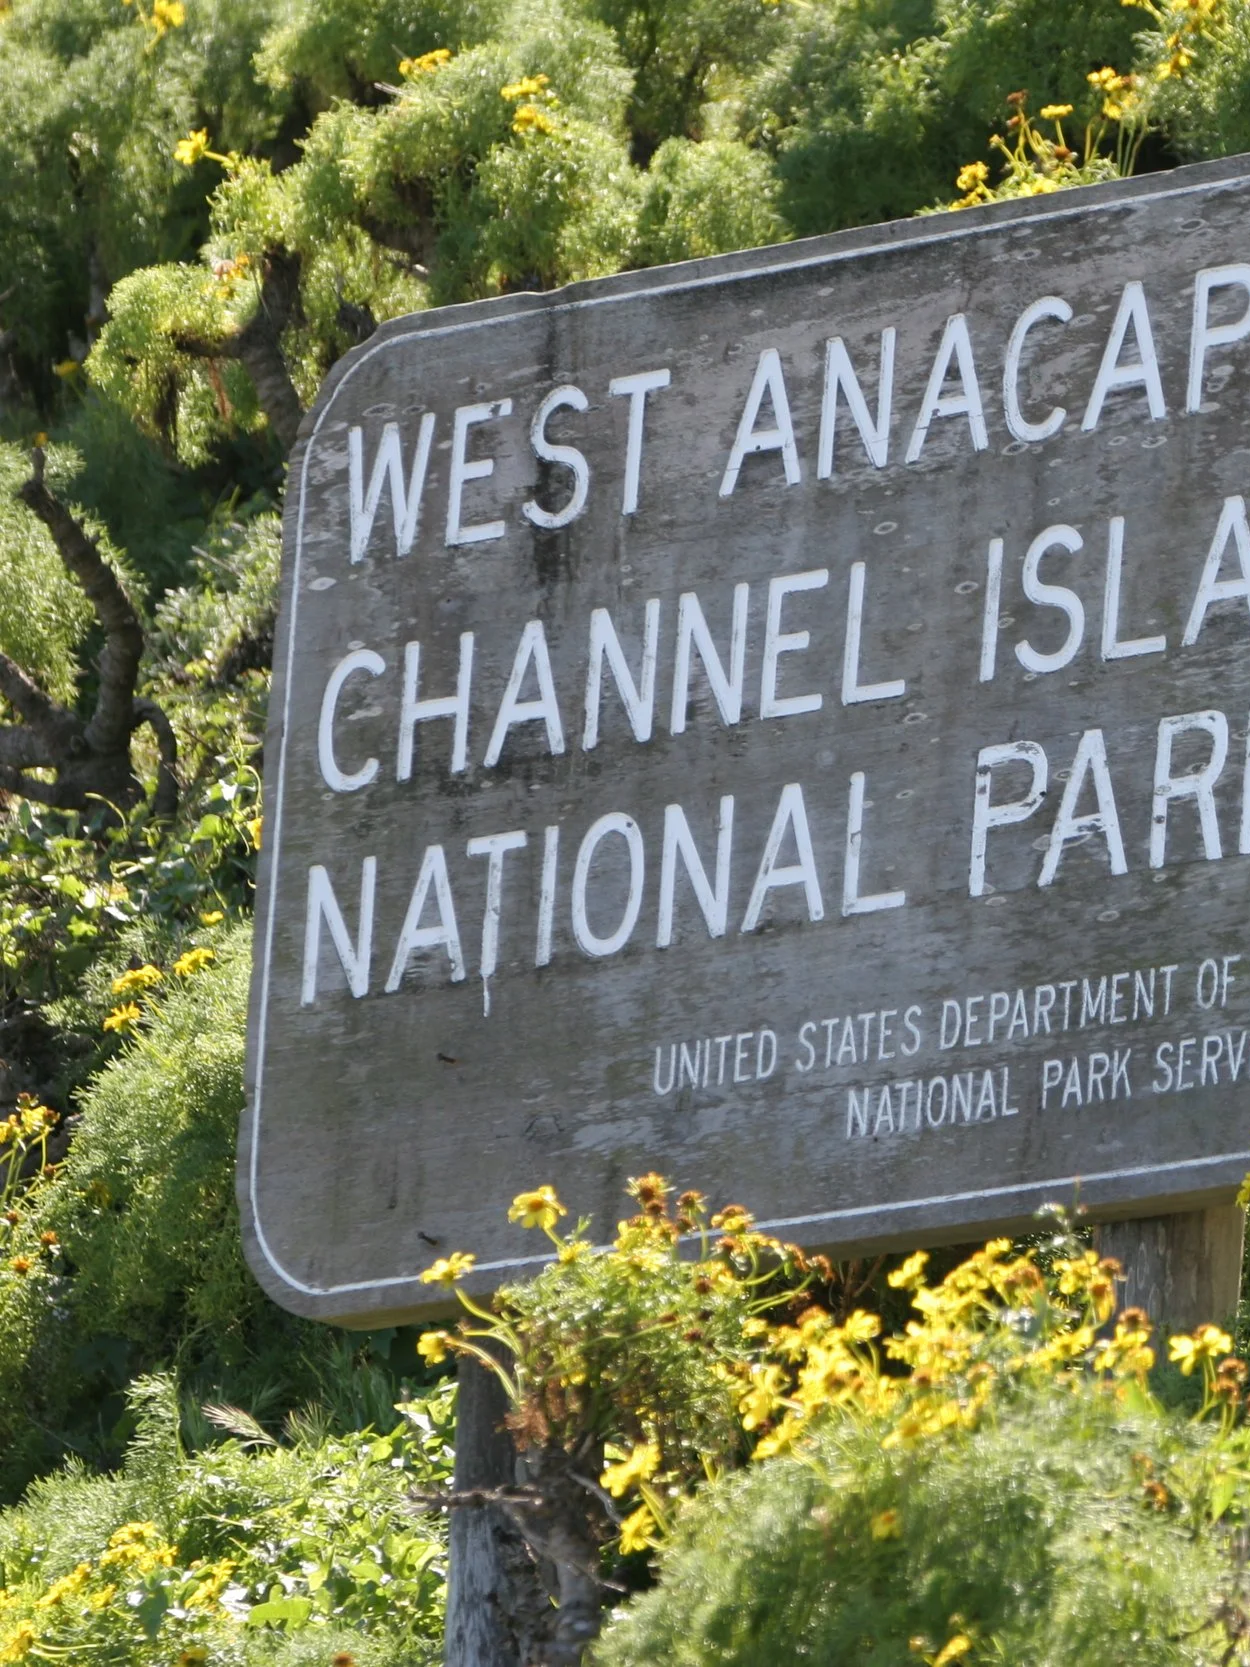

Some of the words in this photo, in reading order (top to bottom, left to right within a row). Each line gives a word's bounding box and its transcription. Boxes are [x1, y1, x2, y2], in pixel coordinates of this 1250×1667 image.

[347, 367, 671, 565] WEST
[318, 562, 906, 793] CHANNEL
[301, 772, 906, 1007] NATIONAL
[653, 1029, 778, 1096] UNITED
[795, 1004, 922, 1073] STATES
[939, 964, 1178, 1050] DEPARTMENT
[1196, 954, 1241, 1009] OF
[846, 1066, 1019, 1140] NATIONAL
[1042, 1047, 1132, 1109] PARK
